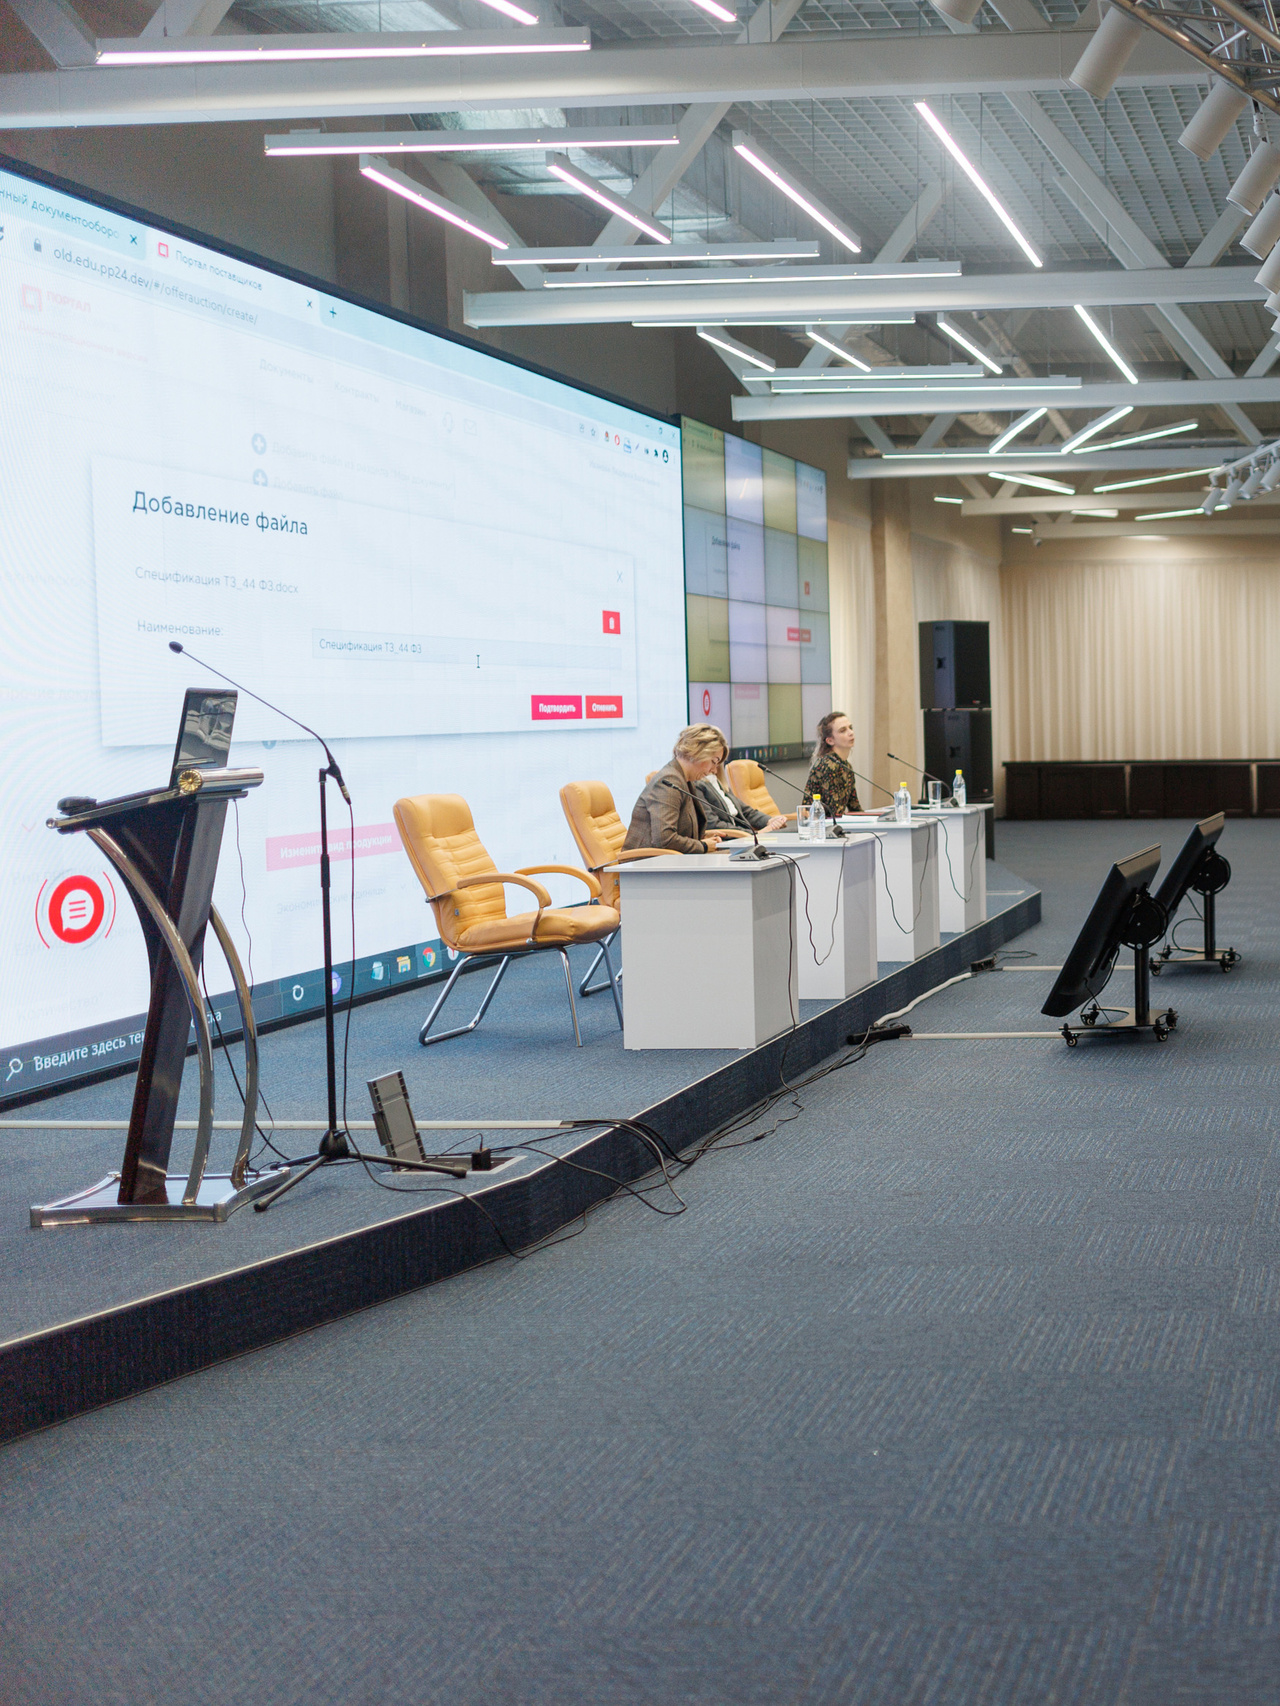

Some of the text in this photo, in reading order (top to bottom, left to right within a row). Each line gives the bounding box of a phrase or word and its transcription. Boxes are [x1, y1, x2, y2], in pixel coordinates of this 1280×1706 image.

[176, 250, 262, 291] Портал поставщиков
[53, 248, 258, 325] old.edu.pp24.dev/#/offerauction/create/
[47, 290, 91, 313] ПОРТАЛ
[259, 357, 314, 384] Документы
[333, 381, 380, 403] Контракты
[132, 490, 309, 535] Добавление файла
[135, 566, 221, 586] Спецификация
[258, 579, 299, 594] ФЗ.docx
[136, 619, 224, 637] Наименование:
[319, 638, 383, 654] Спецификация
[410, 643, 422, 654] ФЗ
[538, 703, 617, 714] Подтвердить Отменить
[34, 1048, 88, 1072] Введите
[91, 1037, 126, 1056] здесь
